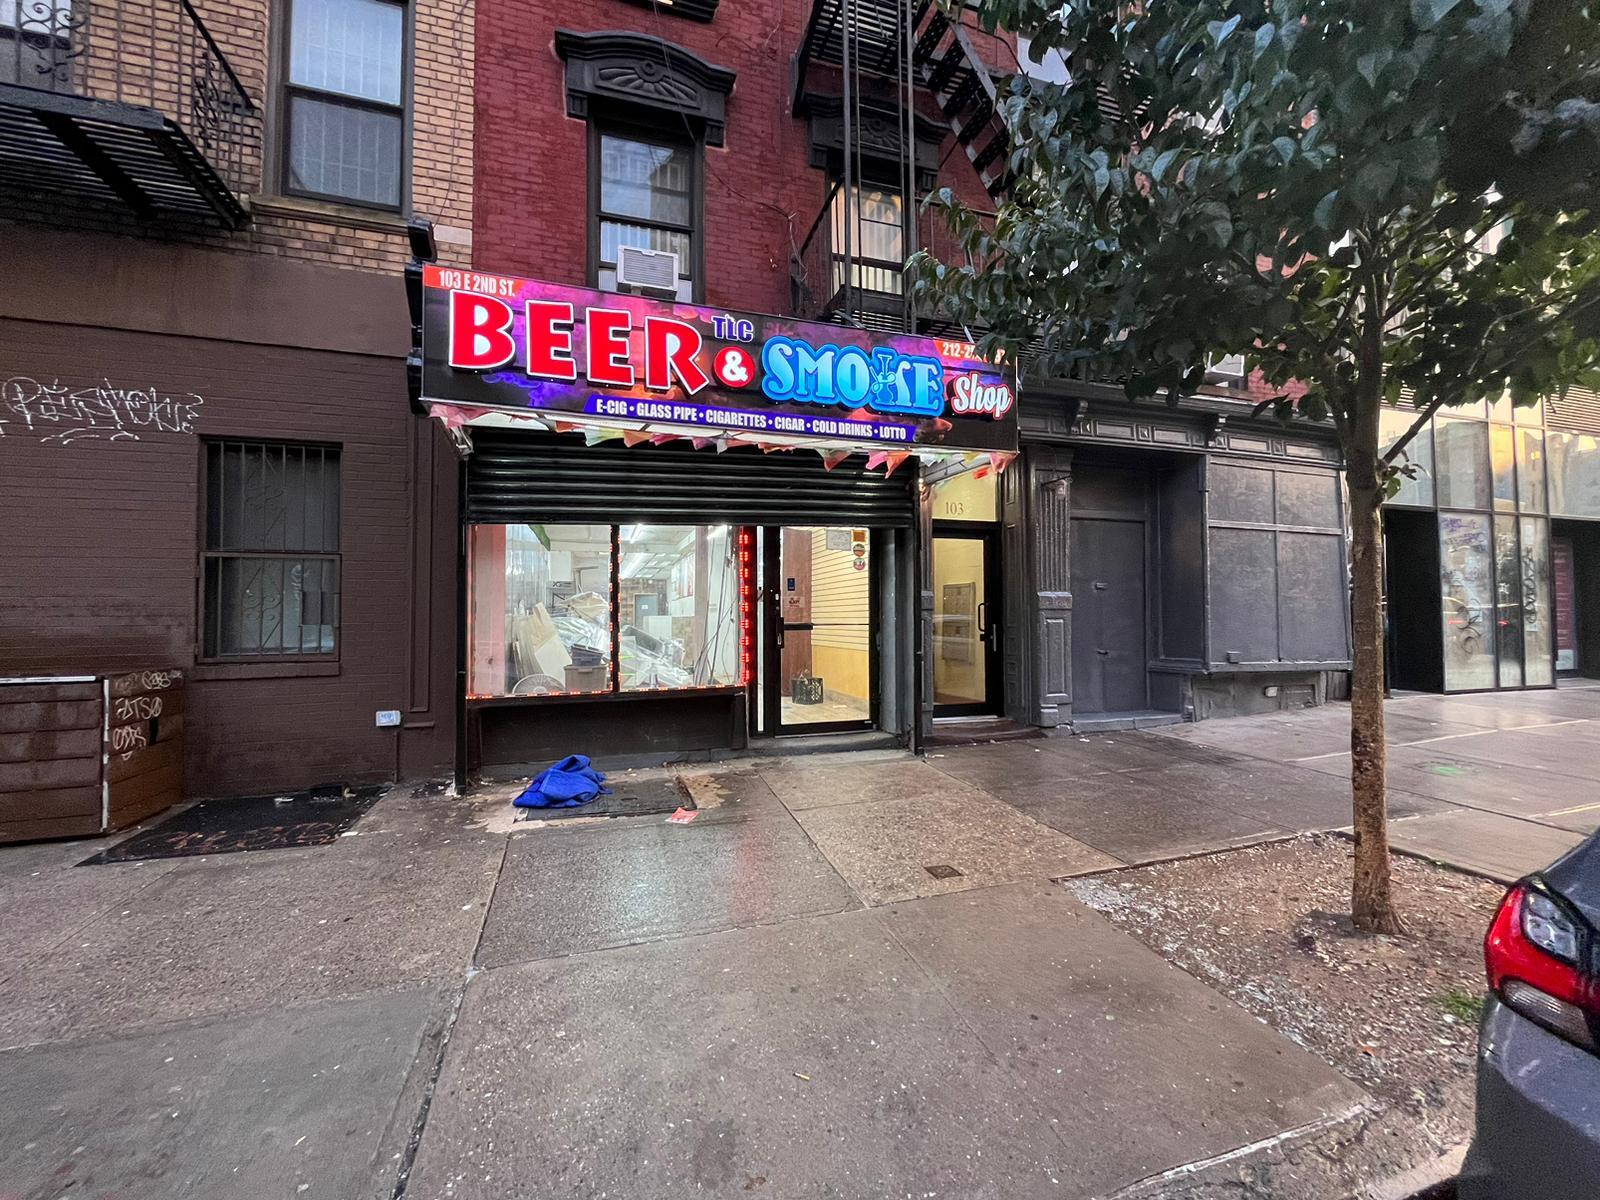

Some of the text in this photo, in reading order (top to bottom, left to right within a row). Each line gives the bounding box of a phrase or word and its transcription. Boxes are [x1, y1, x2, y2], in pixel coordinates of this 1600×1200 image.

[439, 270, 516, 296] 103 E 2ND ST.
[448, 289, 710, 395] BEER
[710, 314, 754, 342] TLC
[721, 350, 749, 382] &
[764, 337, 942, 414] SMOKE
[951, 372, 1013, 419] Shop
[596, 399, 907, 439] E-CIG GLASS PIPE CIGARETTES CIGAR COLD DRINKS LOTTO
[945, 502, 964, 515] 103
